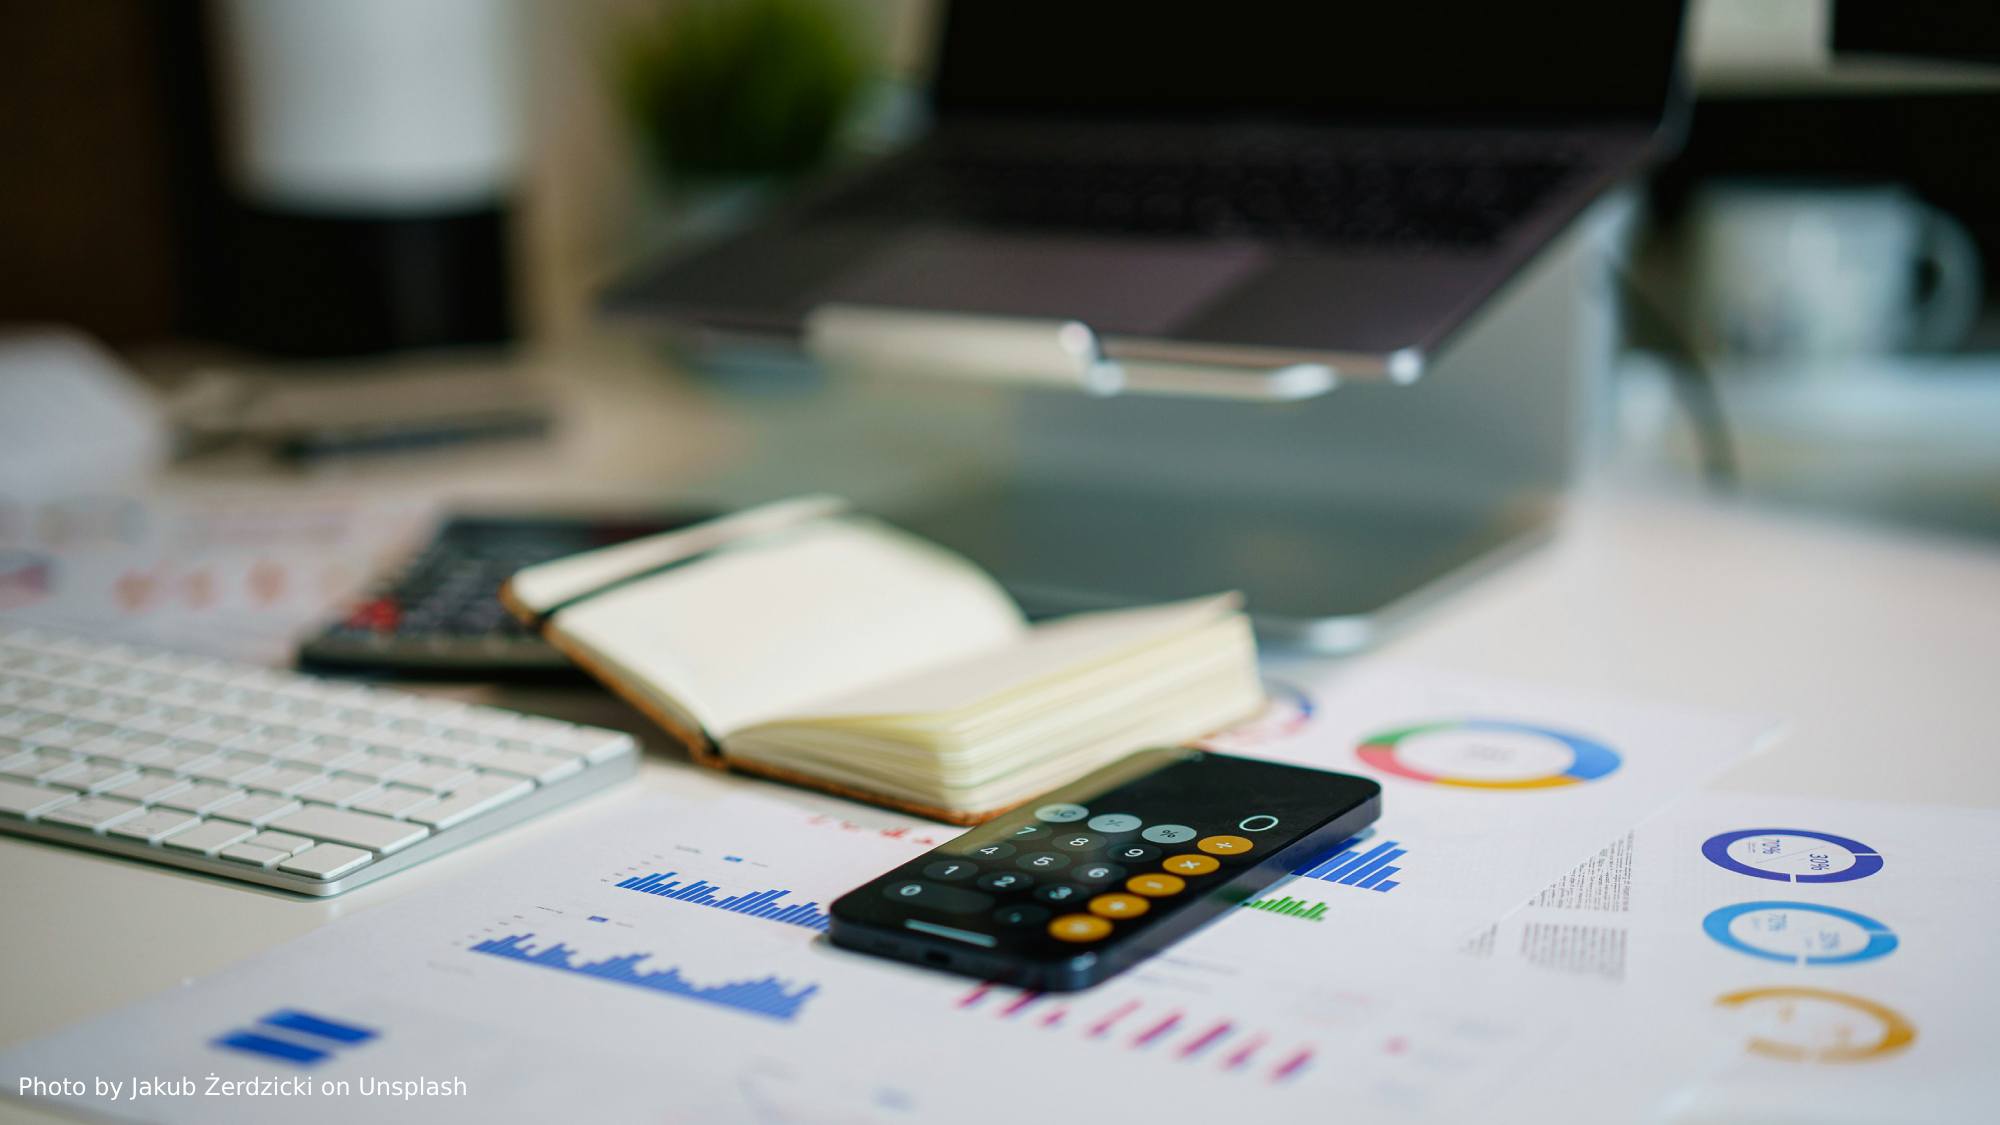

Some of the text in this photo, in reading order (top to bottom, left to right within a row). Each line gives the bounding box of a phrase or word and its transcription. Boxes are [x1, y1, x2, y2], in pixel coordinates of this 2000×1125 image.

[1016, 826, 1037, 835] 7
[1069, 837, 1089, 847] 8
[1125, 848, 1144, 858] 9
[980, 846, 999, 855] 4
[1033, 856, 1054, 866] 5
[1088, 867, 1109, 878] 6
[1809, 853, 1830, 871] 30%
[944, 865, 959, 875] 1
[993, 875, 1016, 887] 2
[900, 884, 922, 896] 0
